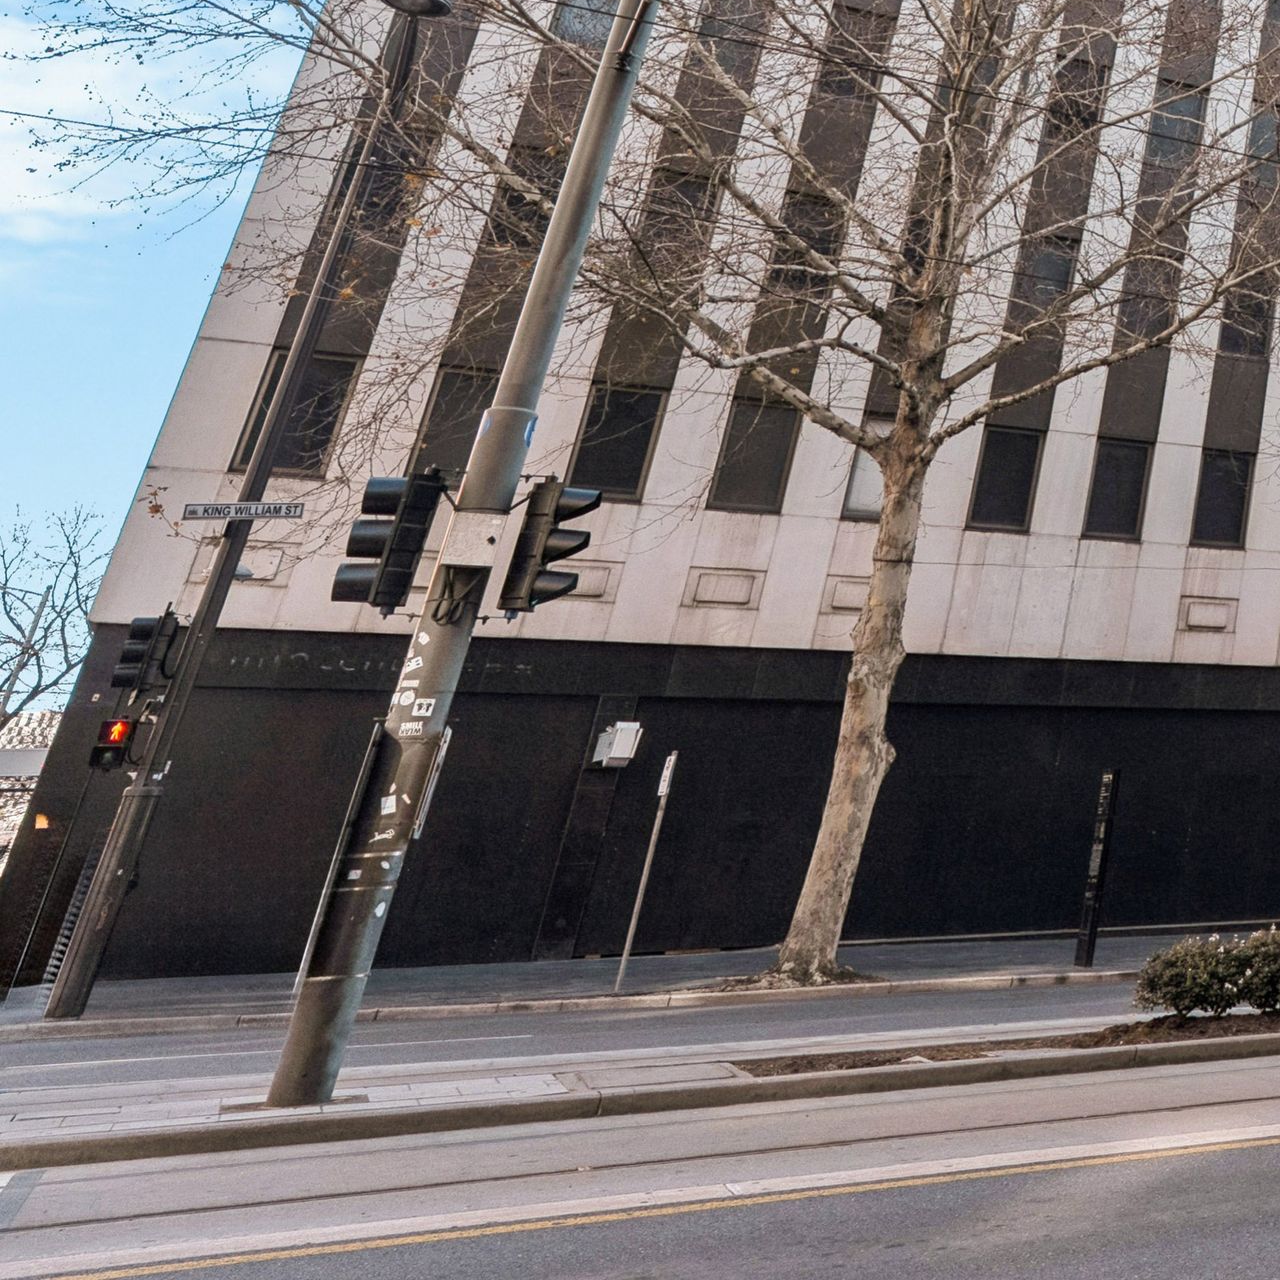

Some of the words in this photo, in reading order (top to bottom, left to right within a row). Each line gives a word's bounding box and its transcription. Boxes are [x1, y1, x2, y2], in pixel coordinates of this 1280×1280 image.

[202, 506, 231, 516] KING
[234, 505, 283, 516] WILLIAM
[284, 505, 300, 515] ST
[400, 721, 424, 729] SMILE
